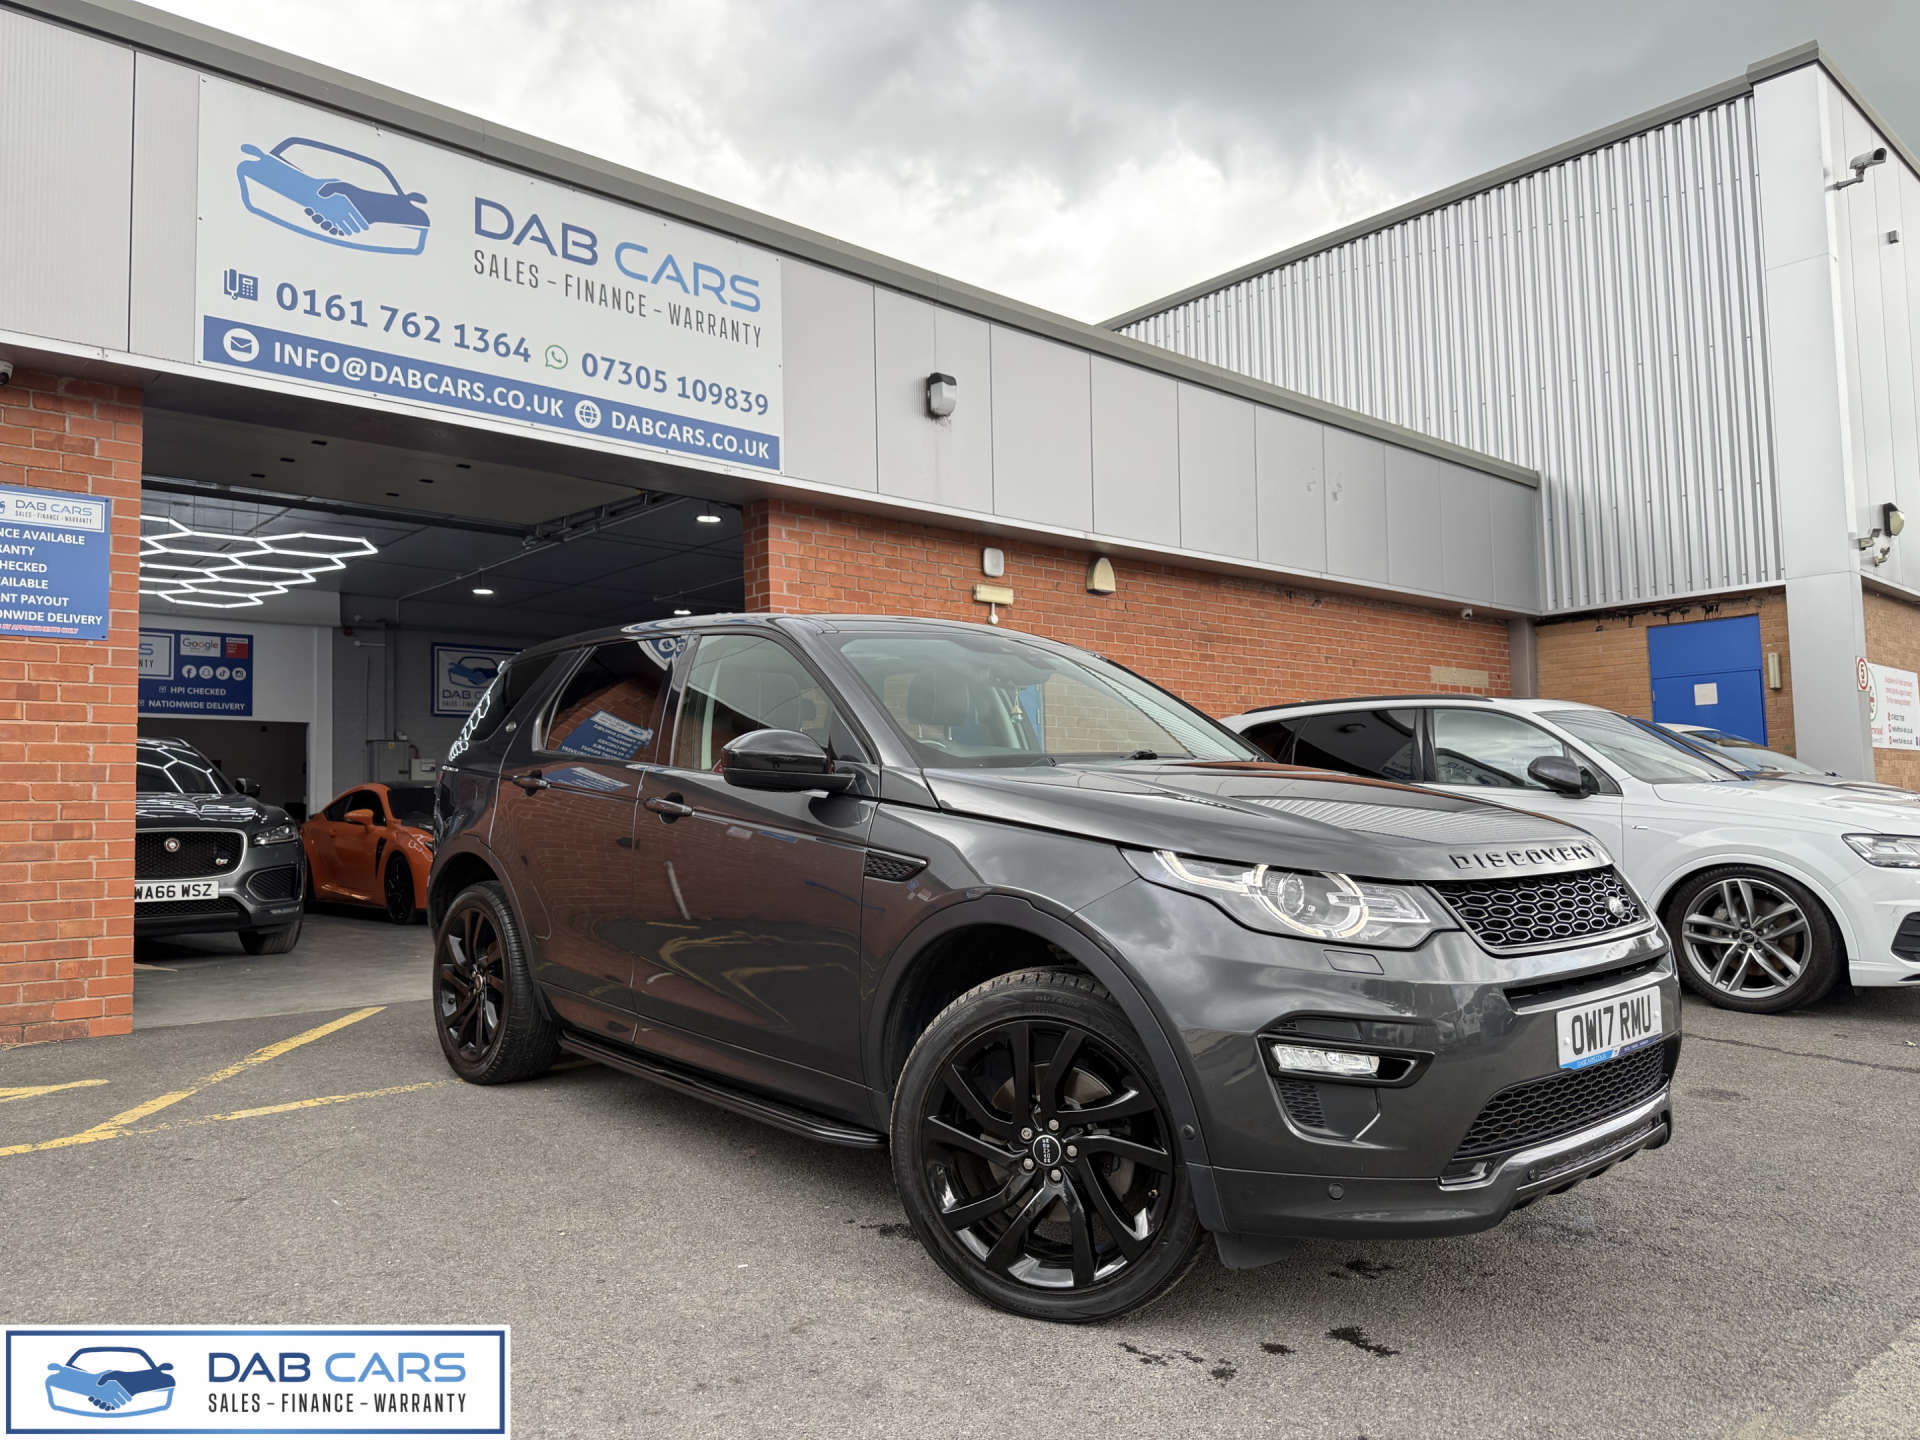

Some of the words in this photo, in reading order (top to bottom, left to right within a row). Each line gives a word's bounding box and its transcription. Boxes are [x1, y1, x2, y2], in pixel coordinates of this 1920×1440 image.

[474, 196, 598, 266] DAB
[614, 241, 761, 312] CARS
[474, 250, 539, 289] SALES
[564, 274, 647, 317] FINANCE
[668, 302, 761, 348] WARRANTY
[275, 282, 368, 327] 0161
[379, 304, 441, 343] 762
[453, 323, 531, 362] 1364
[581, 353, 668, 393] 07305
[677, 376, 769, 415] 109839
[273, 341, 565, 418] INFO@DABCARS.CO.UK
[611, 411, 770, 460] DABCARS.CO.UK
[15, 499, 47, 511] DAB
[50, 503, 93, 516] CARS
[23, 530, 86, 545] AVAILABLE
[0, 576, 49, 590] AILABLE
[20, 593, 70, 607] PAYOUT
[0, 609, 45, 622] NWIDE
[47, 612, 103, 626] DELIVERY
[182, 638, 218, 650] Google
[187, 687, 227, 696] CHECKED
[149, 700, 205, 709] NATIONWIDE
[206, 701, 245, 710] DELIVERY
[1449, 844, 1597, 869] DISCOVERY
[135, 885, 176, 900] WA66
[181, 884, 212, 898] WSZ
[1571, 1010, 1615, 1056] OW17
[1619, 994, 1652, 1041] RMU
